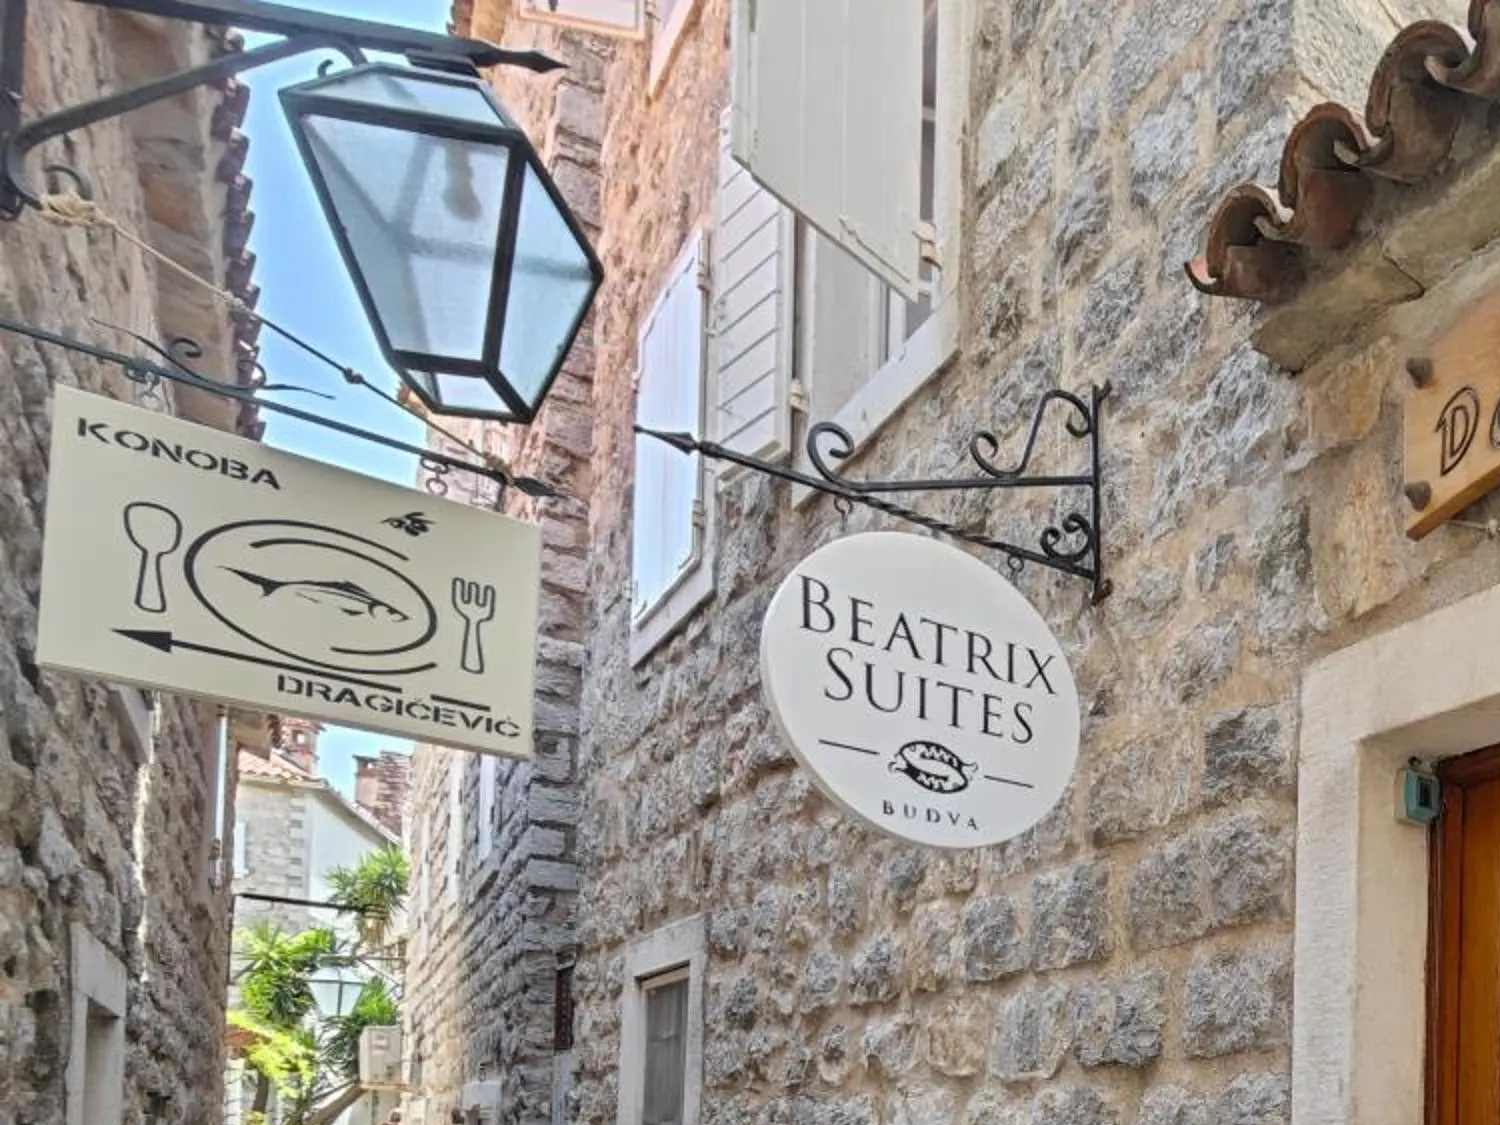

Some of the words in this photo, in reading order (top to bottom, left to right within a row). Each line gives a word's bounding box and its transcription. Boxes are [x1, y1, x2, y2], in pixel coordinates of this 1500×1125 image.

[77, 417, 282, 491] KONOBA
[799, 573, 1058, 695] BEATRIX
[823, 646, 1034, 744] SUITES
[882, 799, 980, 831] BUDVA
